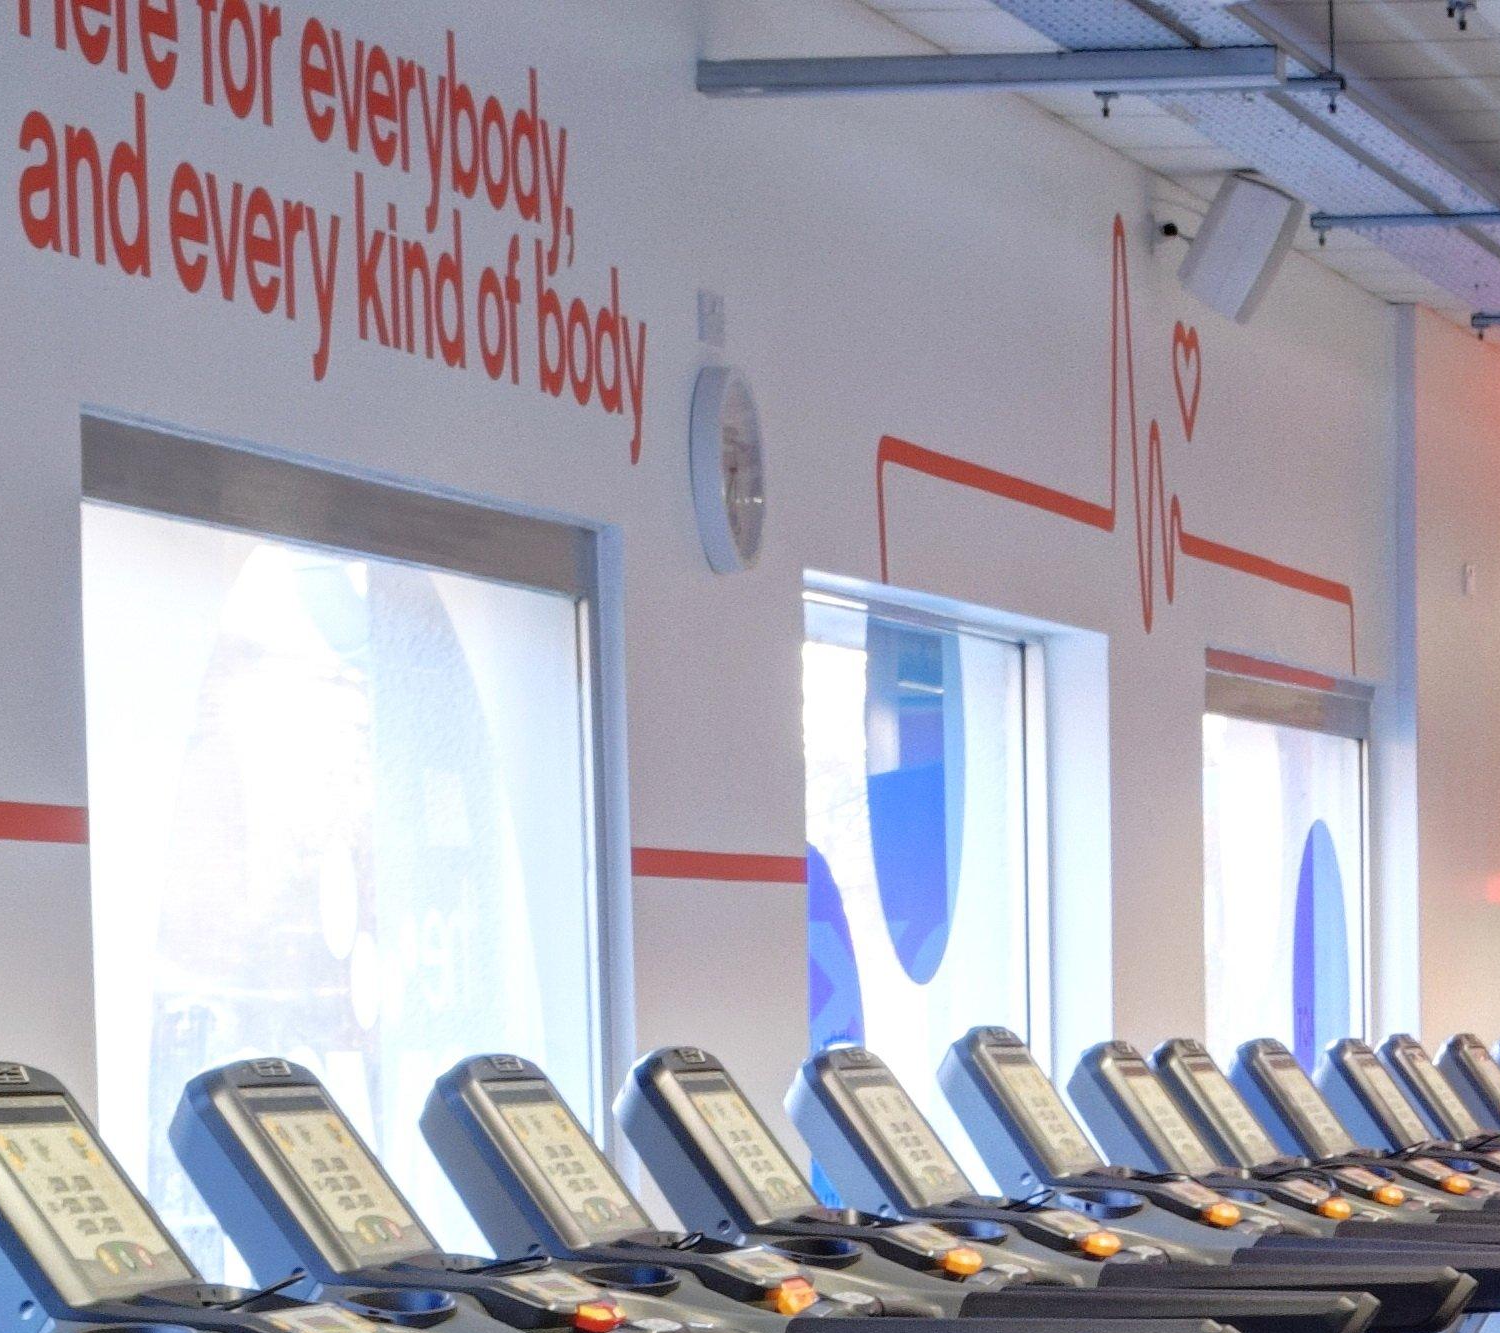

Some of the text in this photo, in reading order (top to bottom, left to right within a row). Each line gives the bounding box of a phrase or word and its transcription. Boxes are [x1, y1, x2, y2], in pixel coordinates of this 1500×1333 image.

[18, 0, 179, 90] ere
[301, 17, 575, 277] everybody,
[18, 91, 647, 466] and every kind of body
